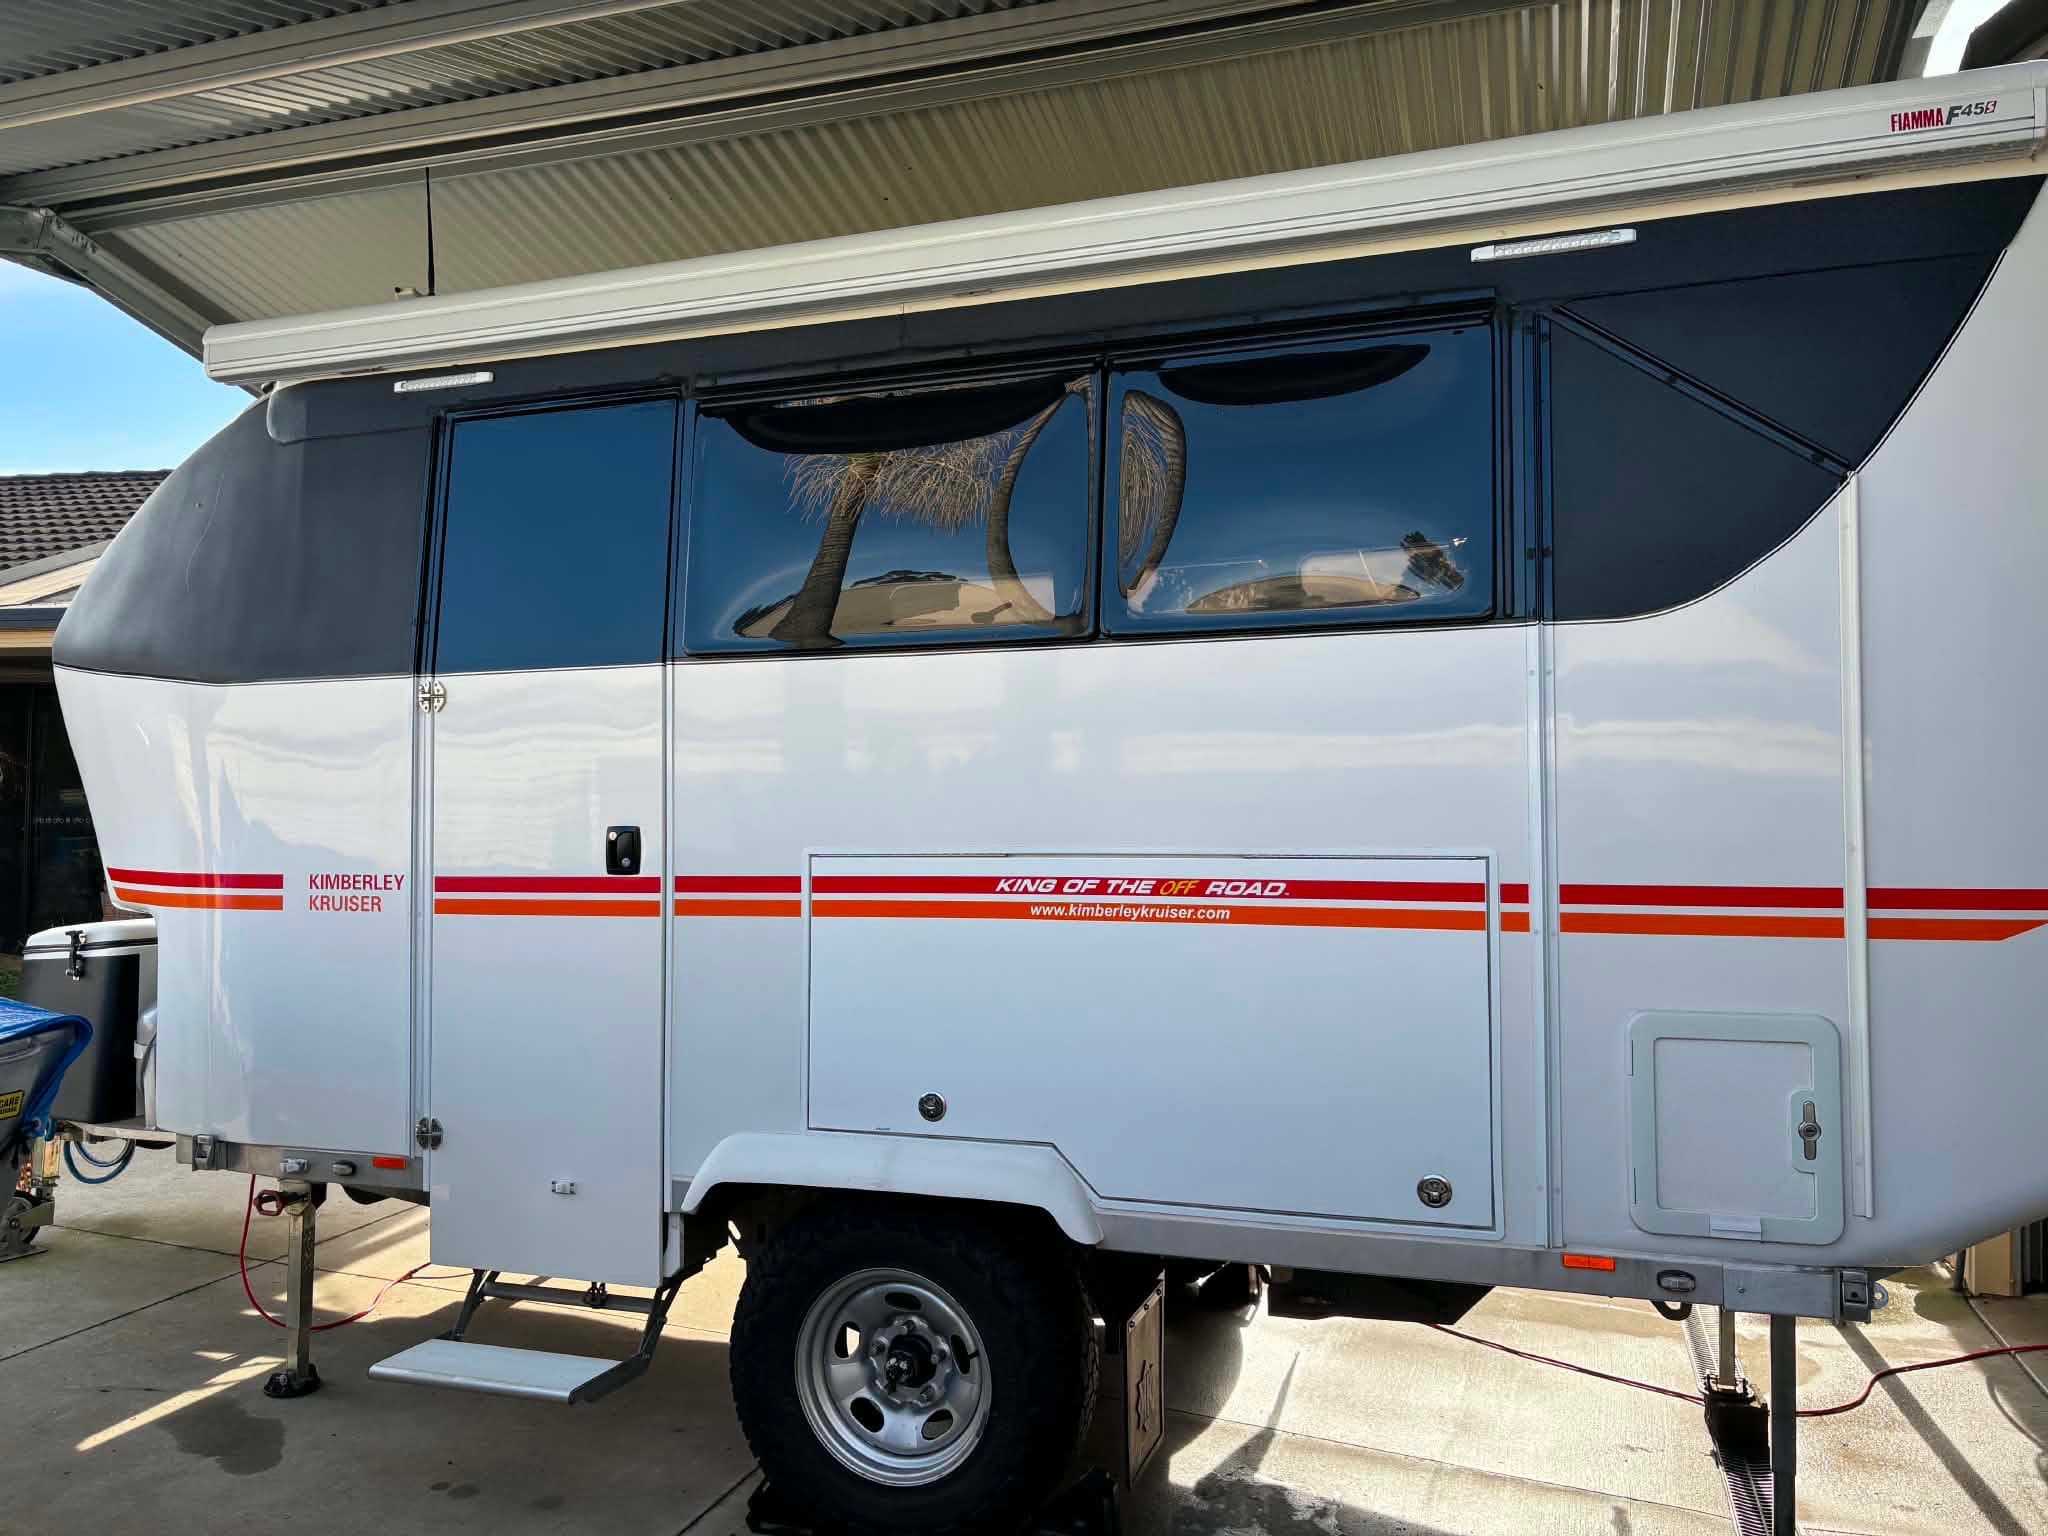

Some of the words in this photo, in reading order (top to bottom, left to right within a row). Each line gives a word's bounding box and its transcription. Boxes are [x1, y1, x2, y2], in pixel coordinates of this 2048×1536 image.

[1891, 108, 1944, 132] FIAMMA
[309, 874, 405, 890] KIMBERLEY
[995, 878, 1058, 893] KING
[1063, 879, 1101, 893] OF
[1107, 879, 1157, 894] THE
[1159, 880, 1200, 895] OFF
[1205, 881, 1287, 896] ROAD
[309, 895, 382, 912] KRUISER
[1030, 903, 1232, 920] www.kimberleykruiser.com
